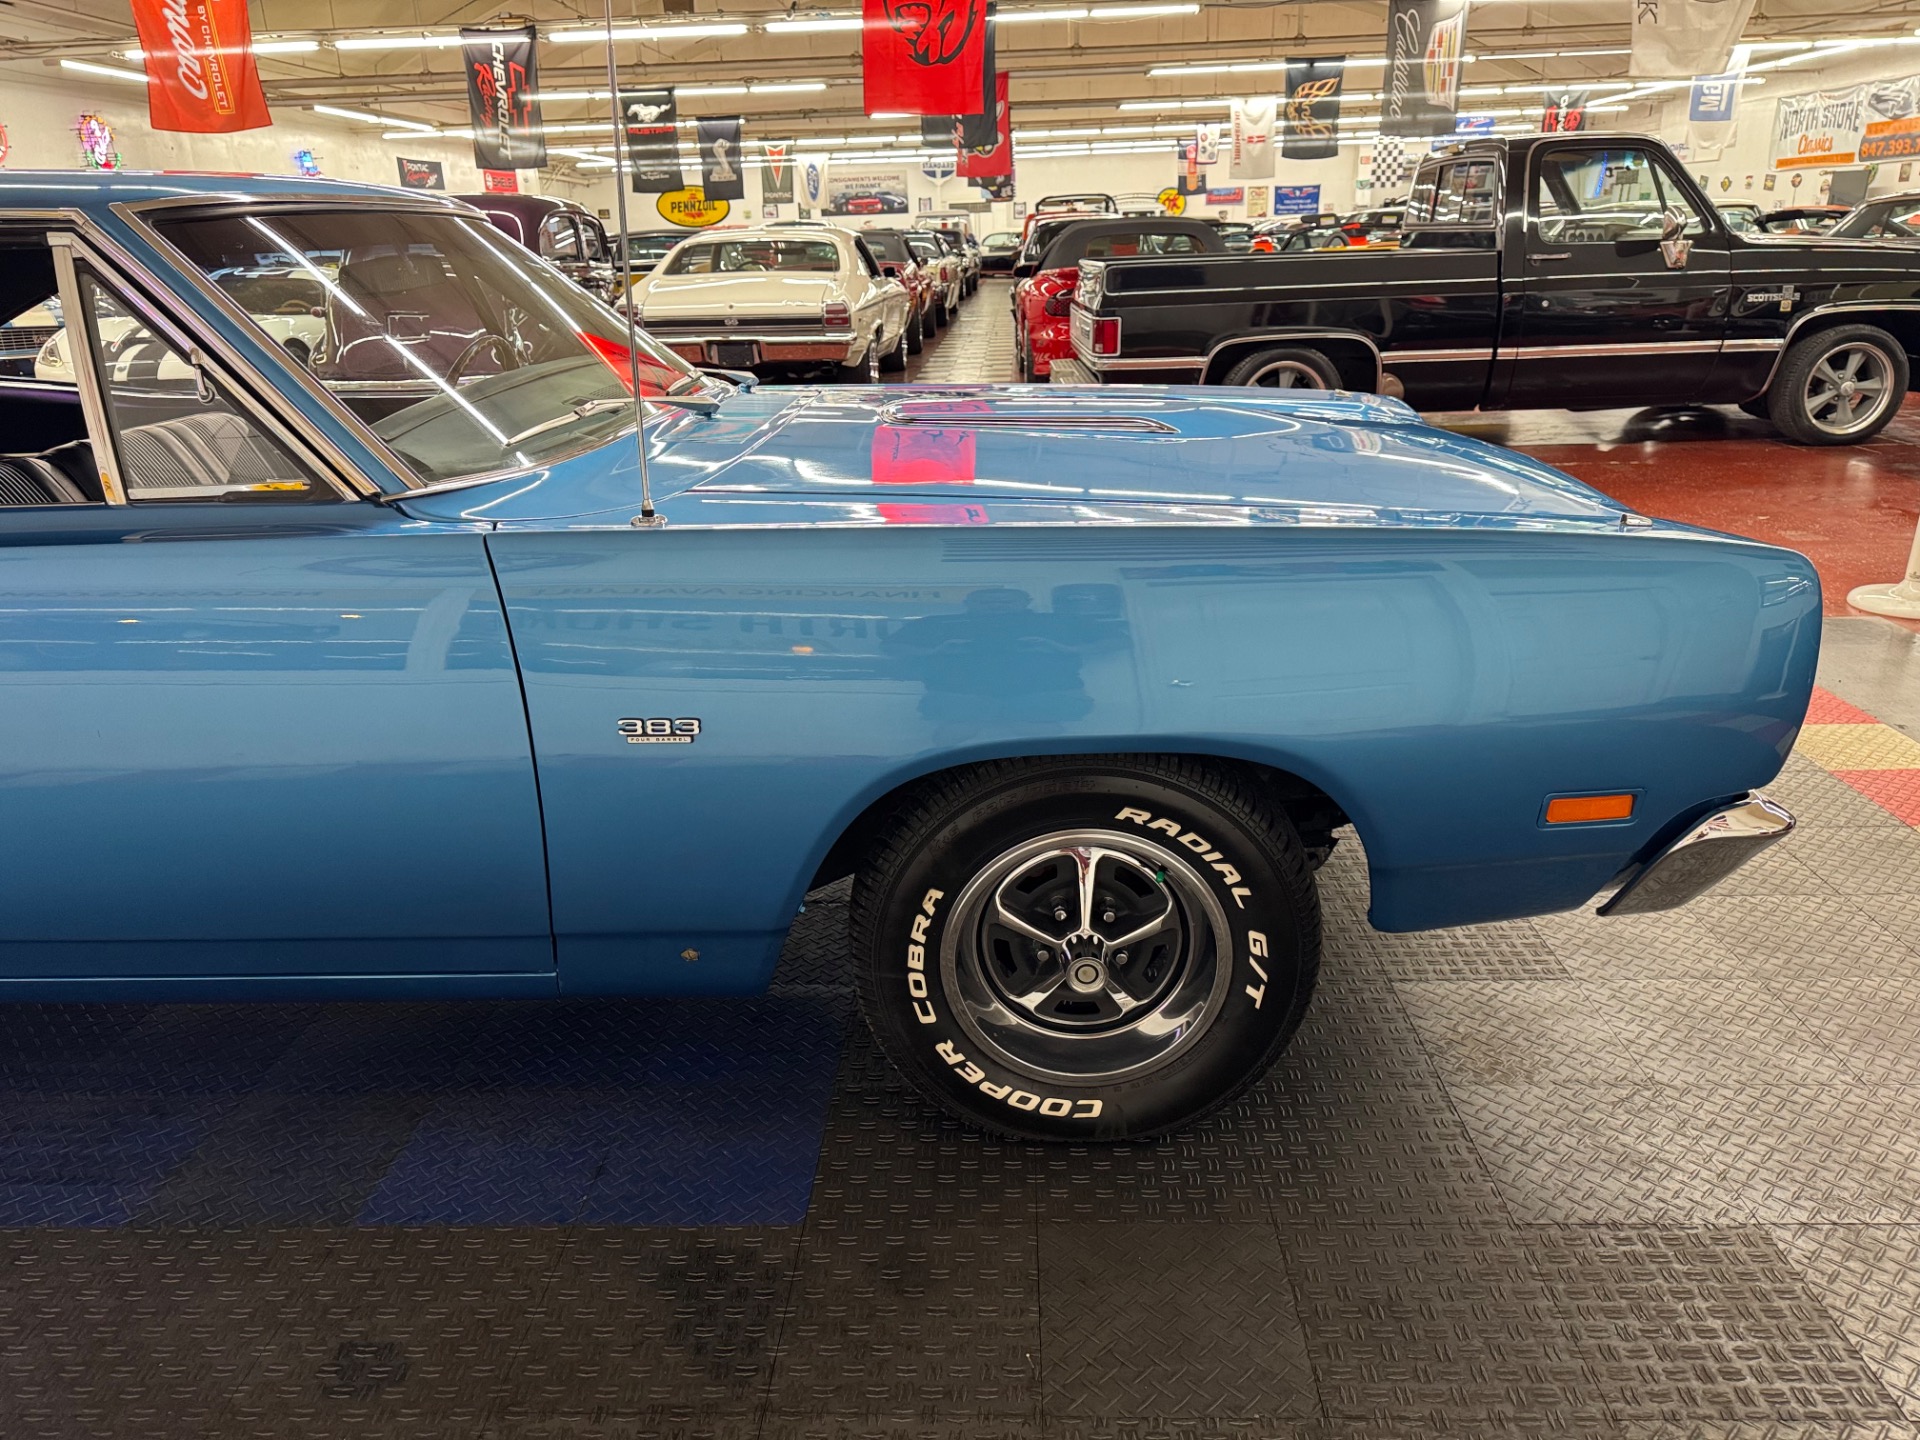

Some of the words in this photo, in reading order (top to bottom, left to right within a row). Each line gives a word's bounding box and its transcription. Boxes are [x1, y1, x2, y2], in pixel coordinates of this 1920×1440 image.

[196, 5, 208, 23] BY
[201, 25, 229, 108] CHEVROLET
[1389, 9, 1421, 119] Cadillac
[474, 62, 496, 128] Racing
[491, 41, 512, 161] CHEVROLET
[628, 125, 675, 134] MUSTANG
[1780, 107, 1820, 141] NORTH
[1822, 100, 1861, 132] SHORE
[1798, 131, 1833, 154] Classics
[829, 175, 871, 183] ONSIGNMENTS
[922, 161, 955, 169] STANDARD
[671, 200, 717, 213] PENNZOIL
[617, 718, 701, 735] 383
[1114, 806, 1252, 909] RADIAL
[1245, 930, 1269, 1009] G/T
[907, 888, 944, 1024] COBRA
[935, 1039, 1103, 1119] COOPER
